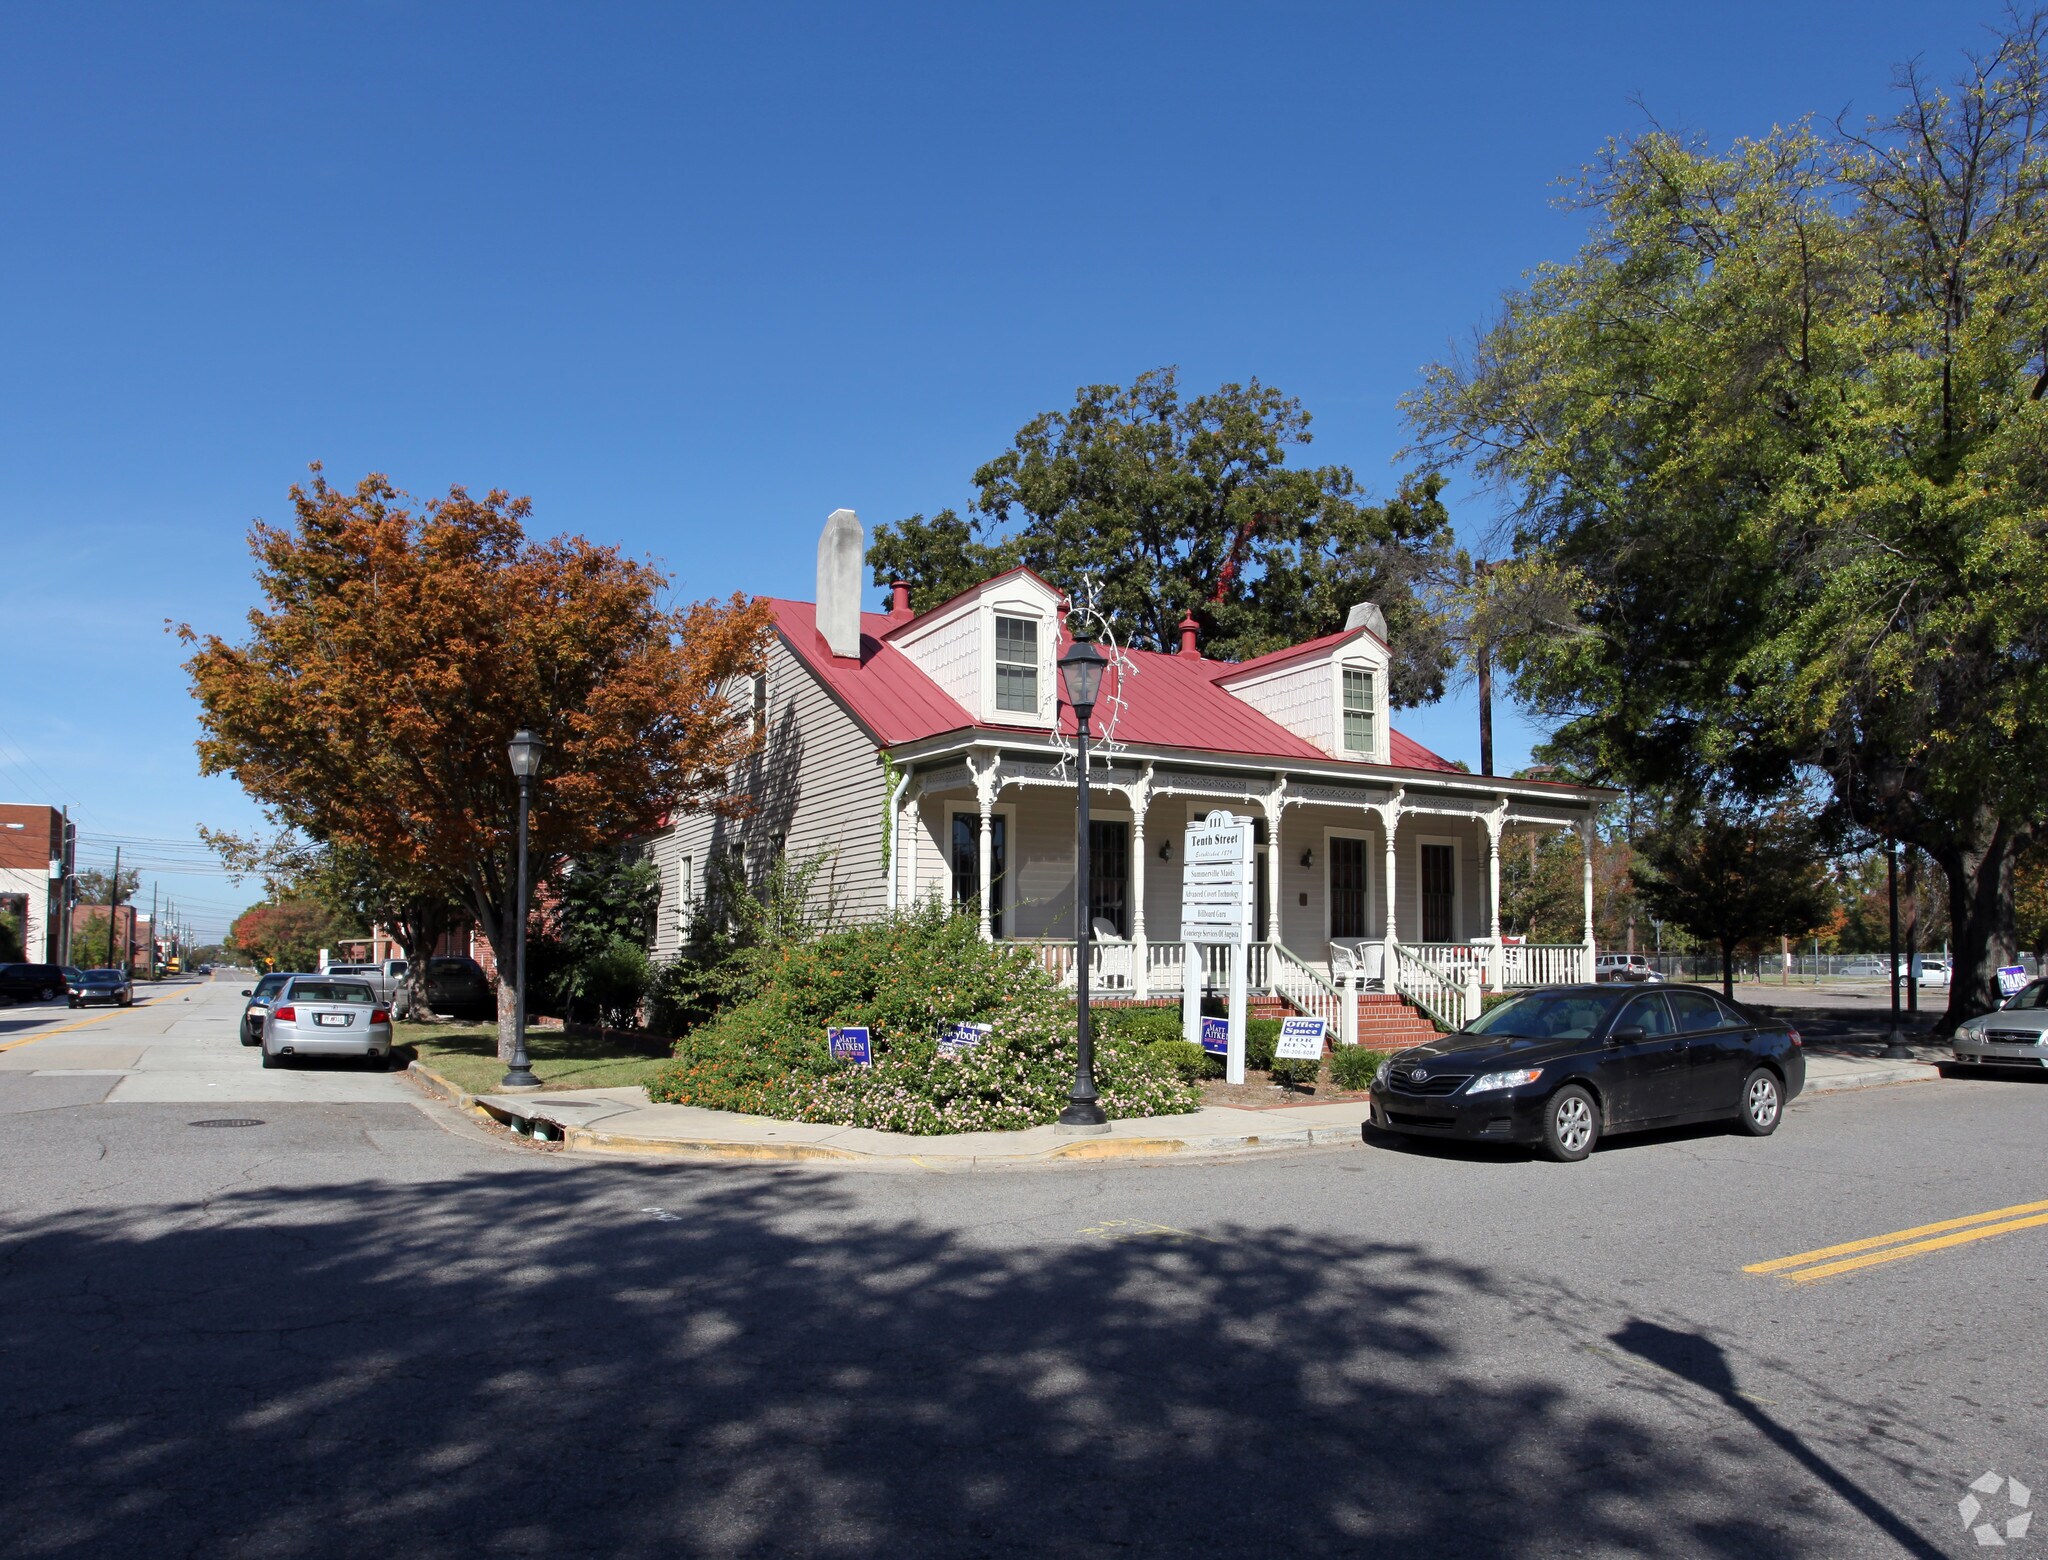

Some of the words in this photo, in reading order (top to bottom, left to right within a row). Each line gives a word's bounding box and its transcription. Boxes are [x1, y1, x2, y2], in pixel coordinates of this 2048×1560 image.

[1209, 818, 1221, 828] 111
[1191, 835, 1213, 847] Tenth
[1215, 833, 1238, 845] Street
[1191, 869, 1220, 878] Summerville
[1220, 869, 1236, 877] Maids
[1185, 889, 1204, 898] Advanced
[1204, 890, 1217, 898] Covert
[1217, 889, 1239, 900] Technology
[1197, 909, 1215, 918] Billboard
[1216, 909, 1227, 918] Guru
[1183, 929, 1202, 938] Concierge
[1202, 929, 1217, 937] Services
[1225, 930, 1239, 939] Augusta
[2000, 973, 2027, 989] EVANS
[1209, 1023, 1226, 1033] MATT
[1285, 1027, 1318, 1035] Space
[838, 1034, 857, 1043] MATT
[834, 1039, 865, 1051] AITKEN
